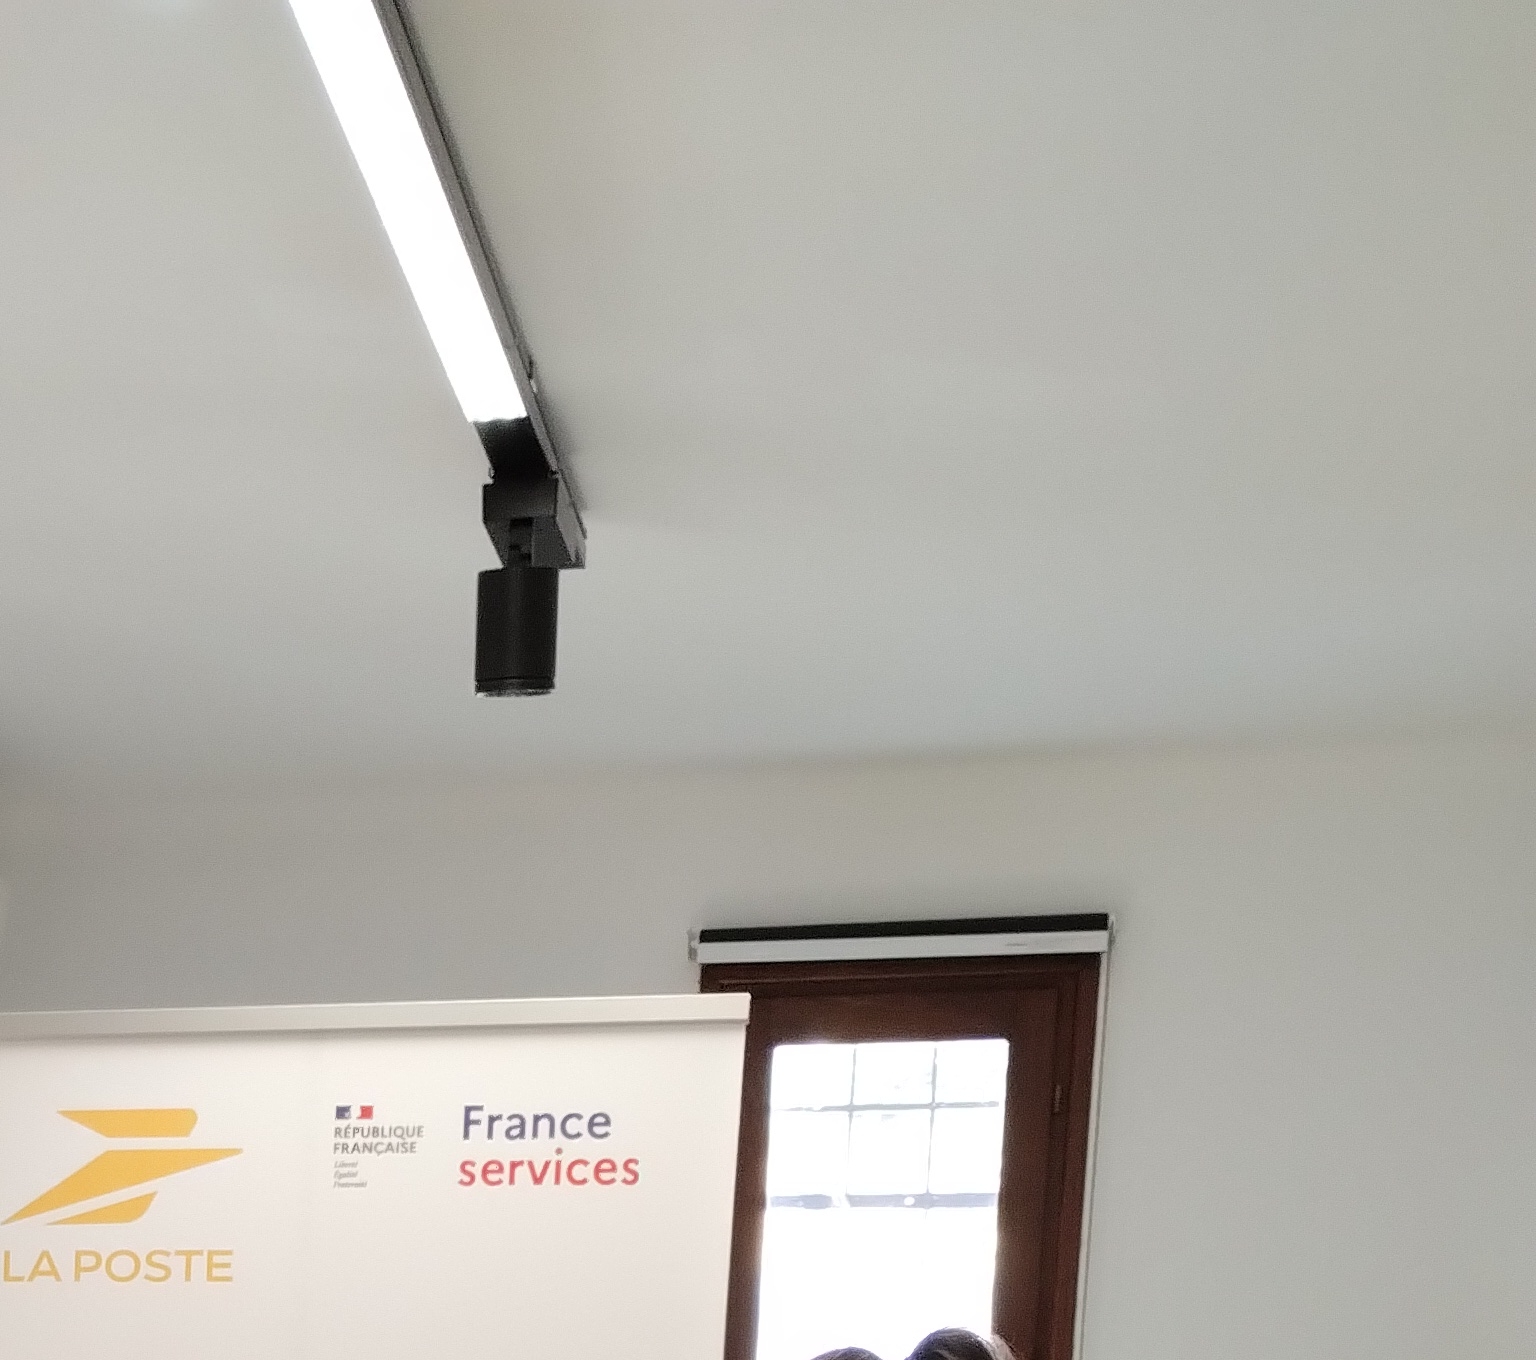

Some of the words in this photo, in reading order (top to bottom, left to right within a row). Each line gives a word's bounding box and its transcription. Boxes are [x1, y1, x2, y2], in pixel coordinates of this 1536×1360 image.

[333, 1123, 424, 1141] RÉPUBLIQUE
[462, 1104, 613, 1142] France
[333, 1141, 417, 1157] FRANÇAISE
[459, 1147, 641, 1187] services
[3, 1250, 61, 1283] LA
[74, 1250, 234, 1283] POSTE
